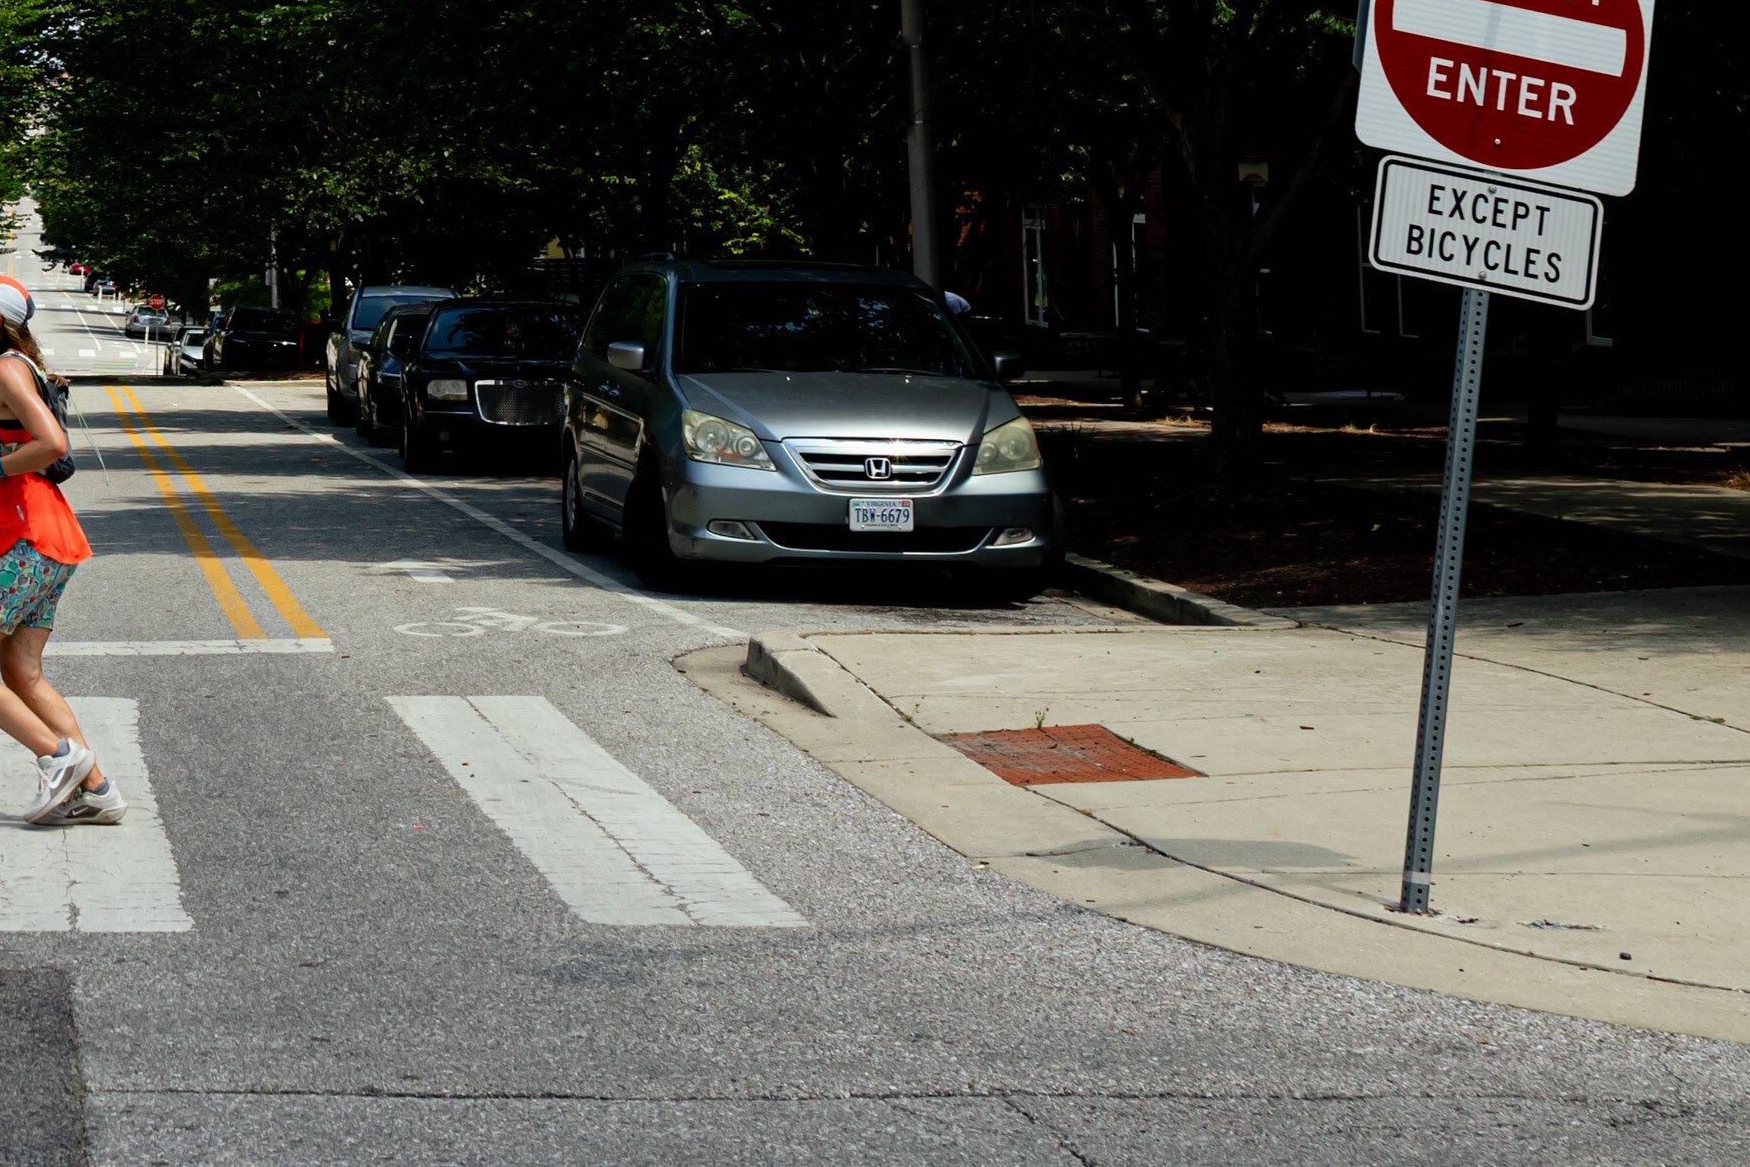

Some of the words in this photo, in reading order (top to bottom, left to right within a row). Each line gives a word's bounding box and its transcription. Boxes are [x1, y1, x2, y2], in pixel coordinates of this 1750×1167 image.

[1426, 56, 1578, 126] ENTER
[1427, 184, 1551, 237] EXCEPT
[1406, 223, 1562, 284] BICYCLES
[150, 298, 164, 306] STOP
[855, 508, 910, 524] TBW-6679
